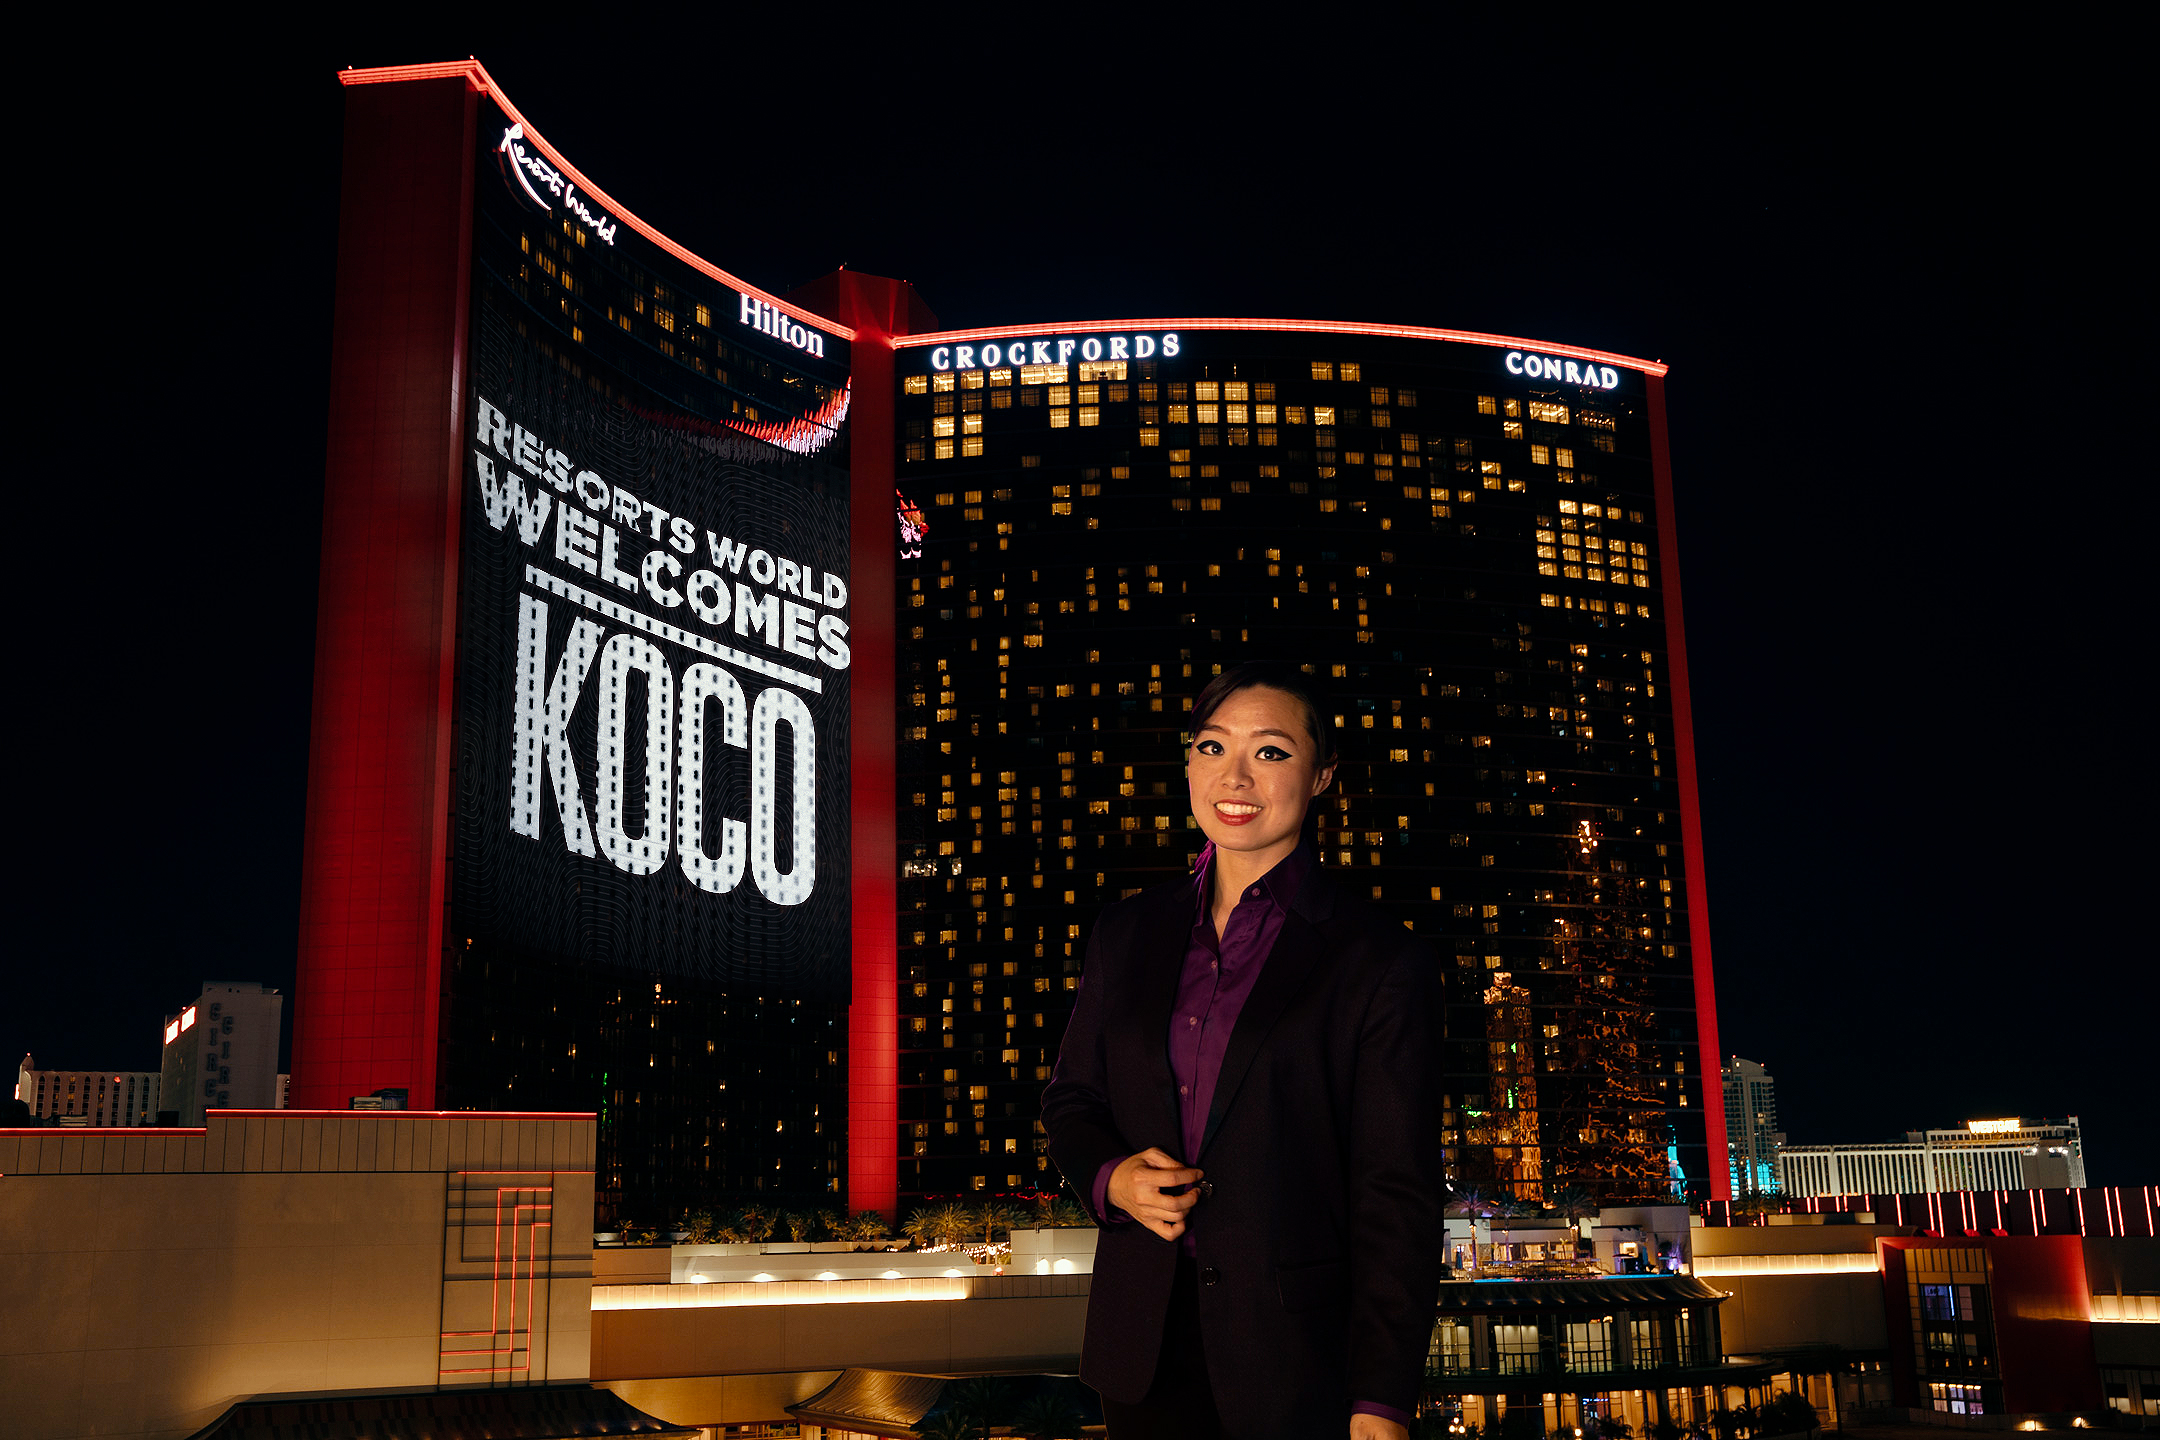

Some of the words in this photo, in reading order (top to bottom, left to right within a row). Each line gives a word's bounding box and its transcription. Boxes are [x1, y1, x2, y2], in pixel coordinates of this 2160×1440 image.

[501, 123, 564, 211] Resorts
[564, 184, 617, 246] World
[740, 292, 824, 358] Hilton
[932, 333, 1180, 371] CROCKFORDS
[1505, 351, 1619, 390] CONRAD
[477, 396, 695, 553] RESORTS
[707, 529, 848, 610] WORLD
[474, 449, 851, 670] WELCOMES
[510, 591, 816, 906] KOCO
[1968, 1119, 2021, 1134] WESTGATE
